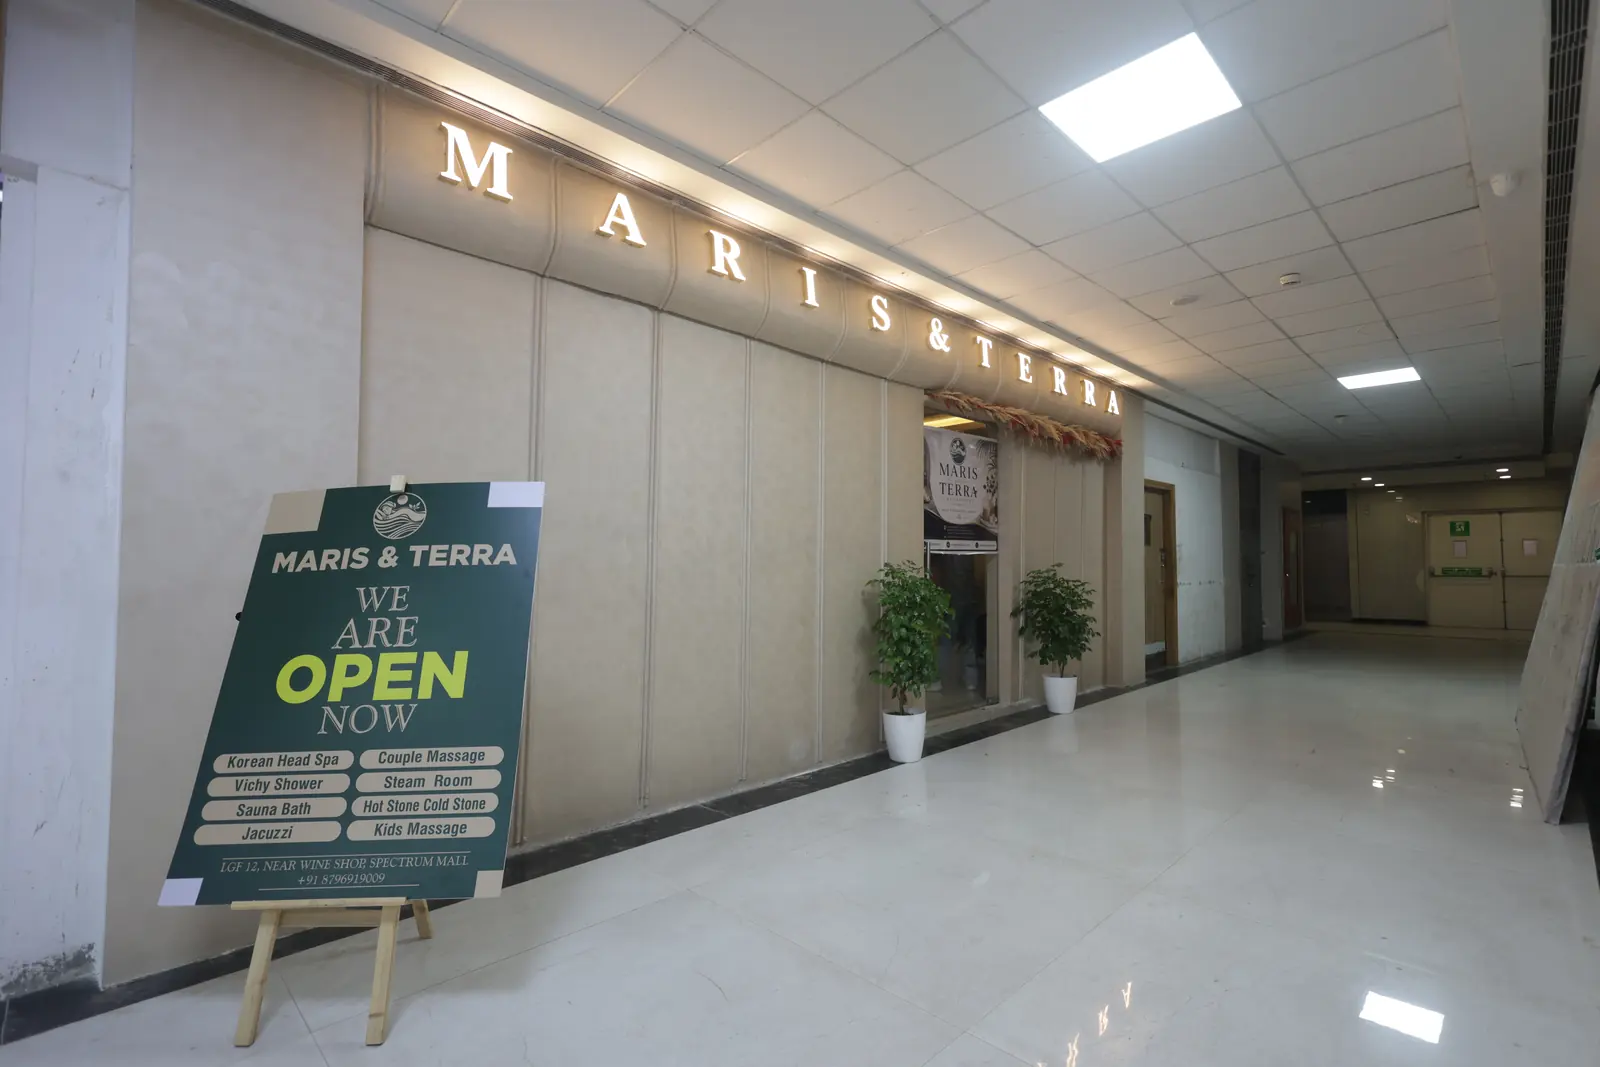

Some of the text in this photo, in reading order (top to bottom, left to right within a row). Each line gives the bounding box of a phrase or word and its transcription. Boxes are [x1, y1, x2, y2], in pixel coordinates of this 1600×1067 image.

[439, 121, 1120, 416] MARIS & TERRA
[940, 462, 978, 480] MARIS
[939, 482, 978, 498] TERRA
[272, 543, 517, 573] MARIS & TERRA
[356, 586, 410, 612] WE
[332, 616, 418, 650] ARE
[275, 650, 468, 704] OPEN
[317, 704, 418, 735] NOW
[227, 754, 339, 768] Korean Head Spa
[378, 749, 485, 765] Couple Massage
[235, 776, 323, 793] Vichy Shower
[384, 774, 473, 789] Steam Room
[236, 802, 311, 816] Sauna Bath
[363, 797, 486, 813] Hot Stone Cold Stone
[242, 825, 292, 840] Jacuzzi
[374, 821, 467, 836] Kids Massage
[220, 856, 469, 873] LGF 12, NEAR WINE SHOP, SPECTRUM MALL
[298, 872, 385, 885] +91 8796919009
